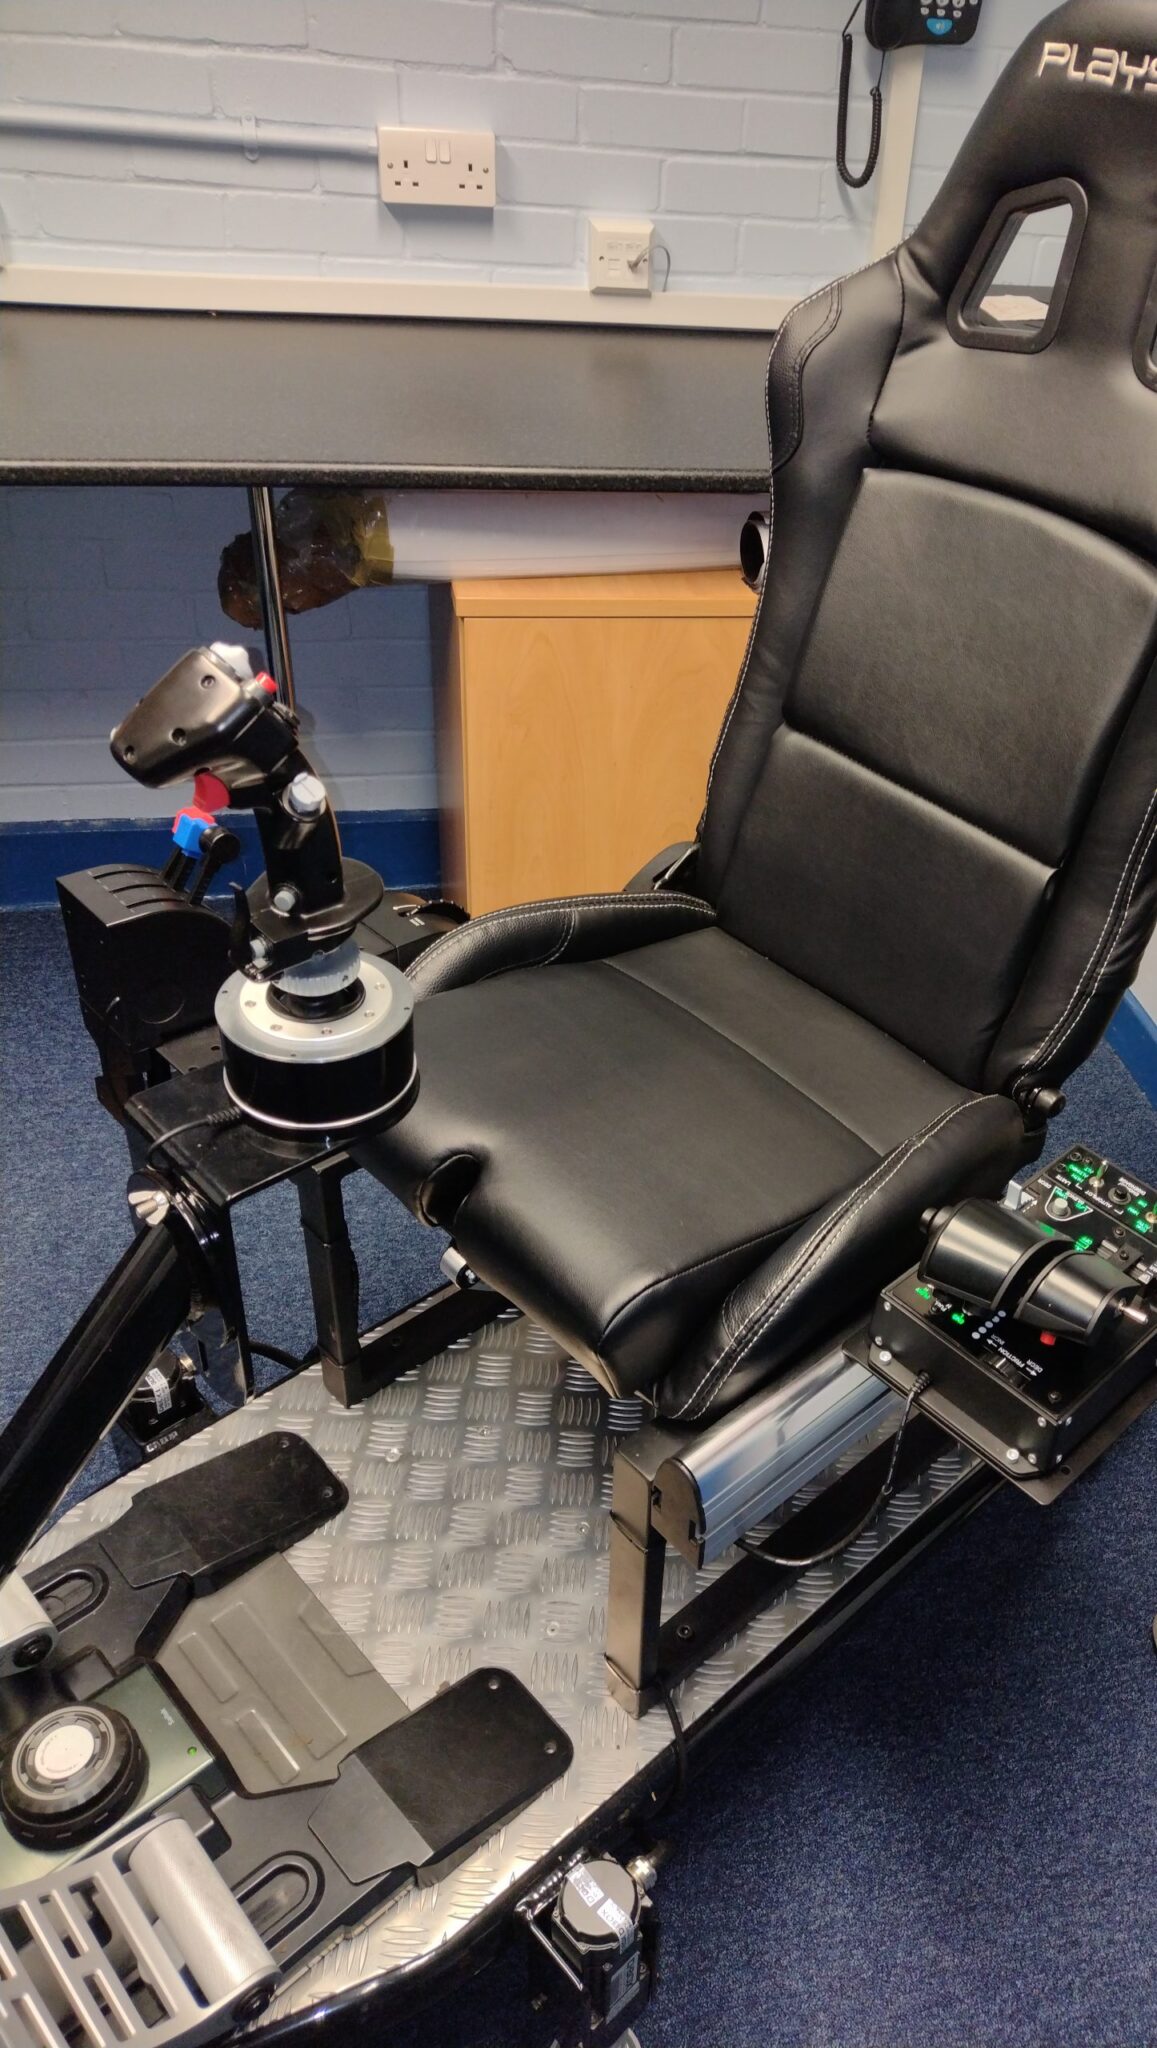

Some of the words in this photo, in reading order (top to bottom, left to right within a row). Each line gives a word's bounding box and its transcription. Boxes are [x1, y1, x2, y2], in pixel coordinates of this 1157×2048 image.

[990, 1333, 1005, 1346] INCR
[998, 1346, 1025, 1368] FRICTION
[1026, 1358, 1043, 1373] DECR
